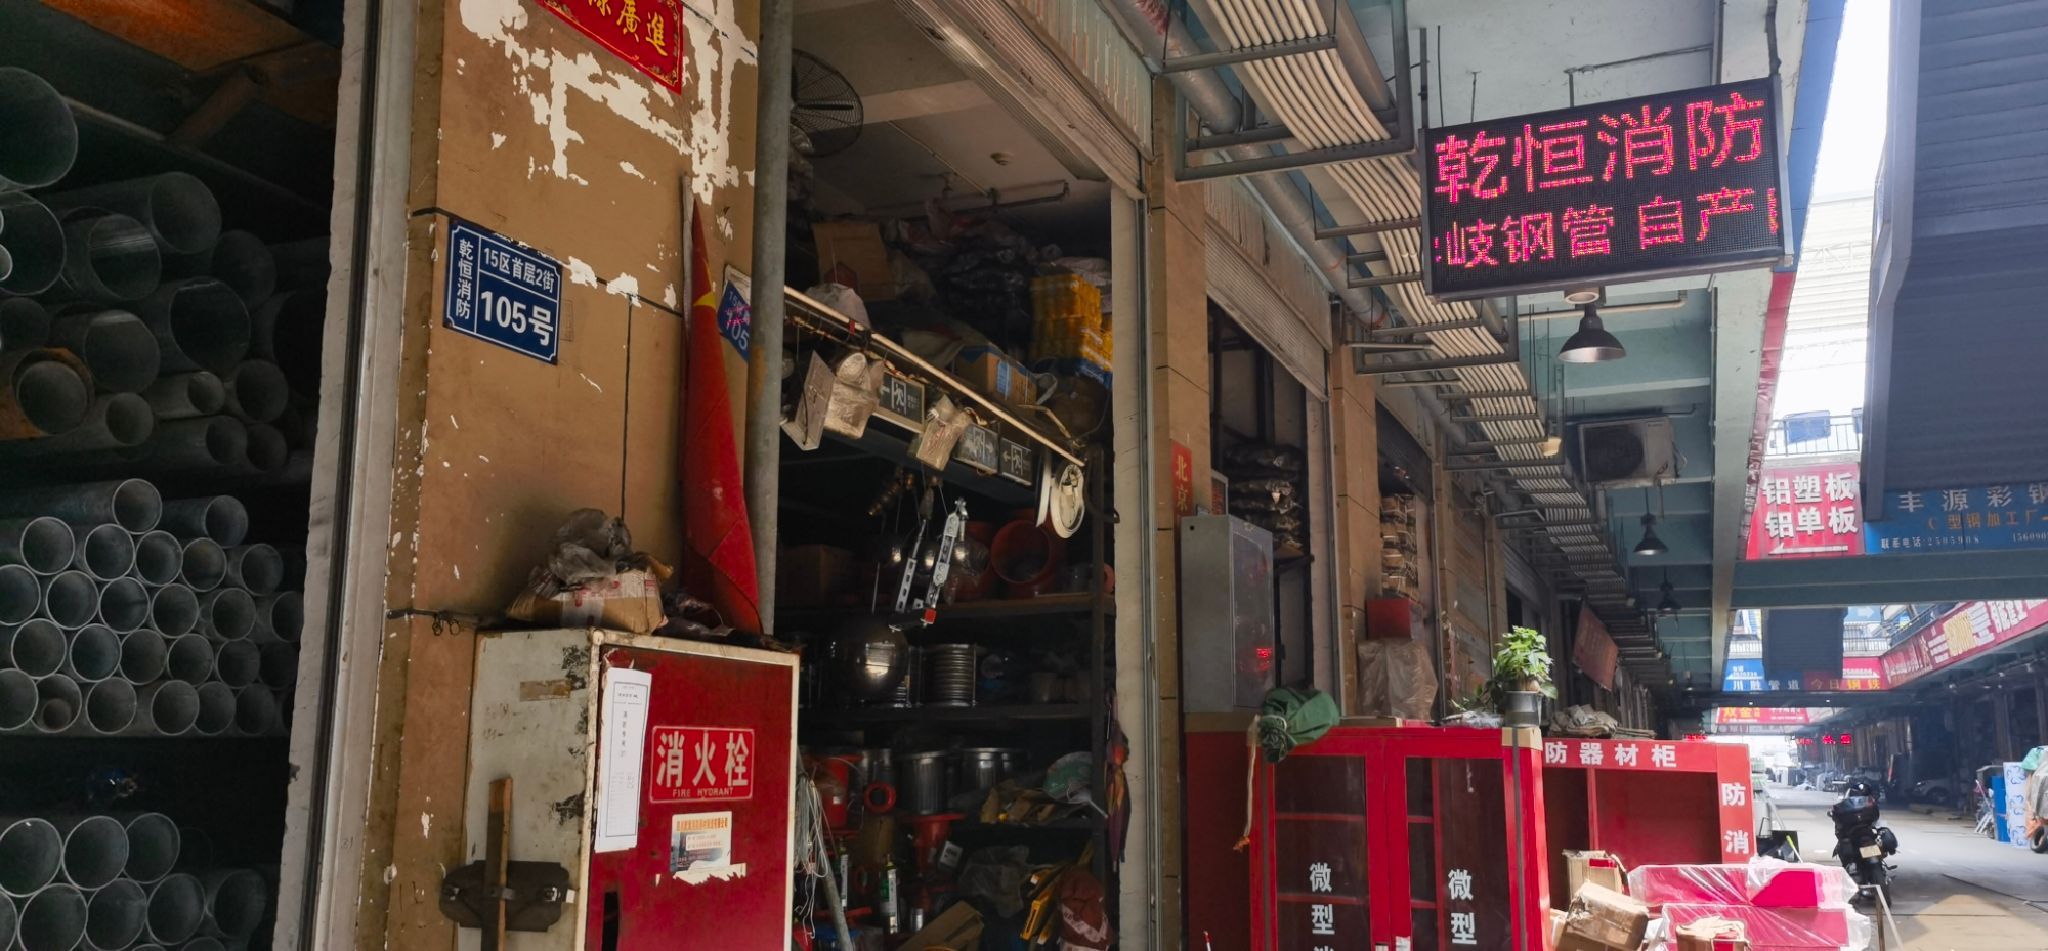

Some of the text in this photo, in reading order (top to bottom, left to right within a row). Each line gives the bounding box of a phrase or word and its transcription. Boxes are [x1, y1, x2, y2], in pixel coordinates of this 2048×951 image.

[1435, 92, 1764, 203] 乾恒消防
[1435, 204, 1614, 268] 岐钢管
[455, 238, 474, 320] 乾恒消防
[484, 247, 555, 294] 15区首层2街
[481, 290, 554, 346] 105号
[1762, 472, 1855, 505] 铝塑板
[1898, 482, 2048, 513] 丰源彩钢
[1764, 506, 1858, 539] 铝单板
[656, 731, 749, 788] 消火栓
[1545, 742, 1677, 768] 防器材柜
[672, 787, 734, 797] FIRE HYDRANT
[1448, 869, 1477, 944] 微型
